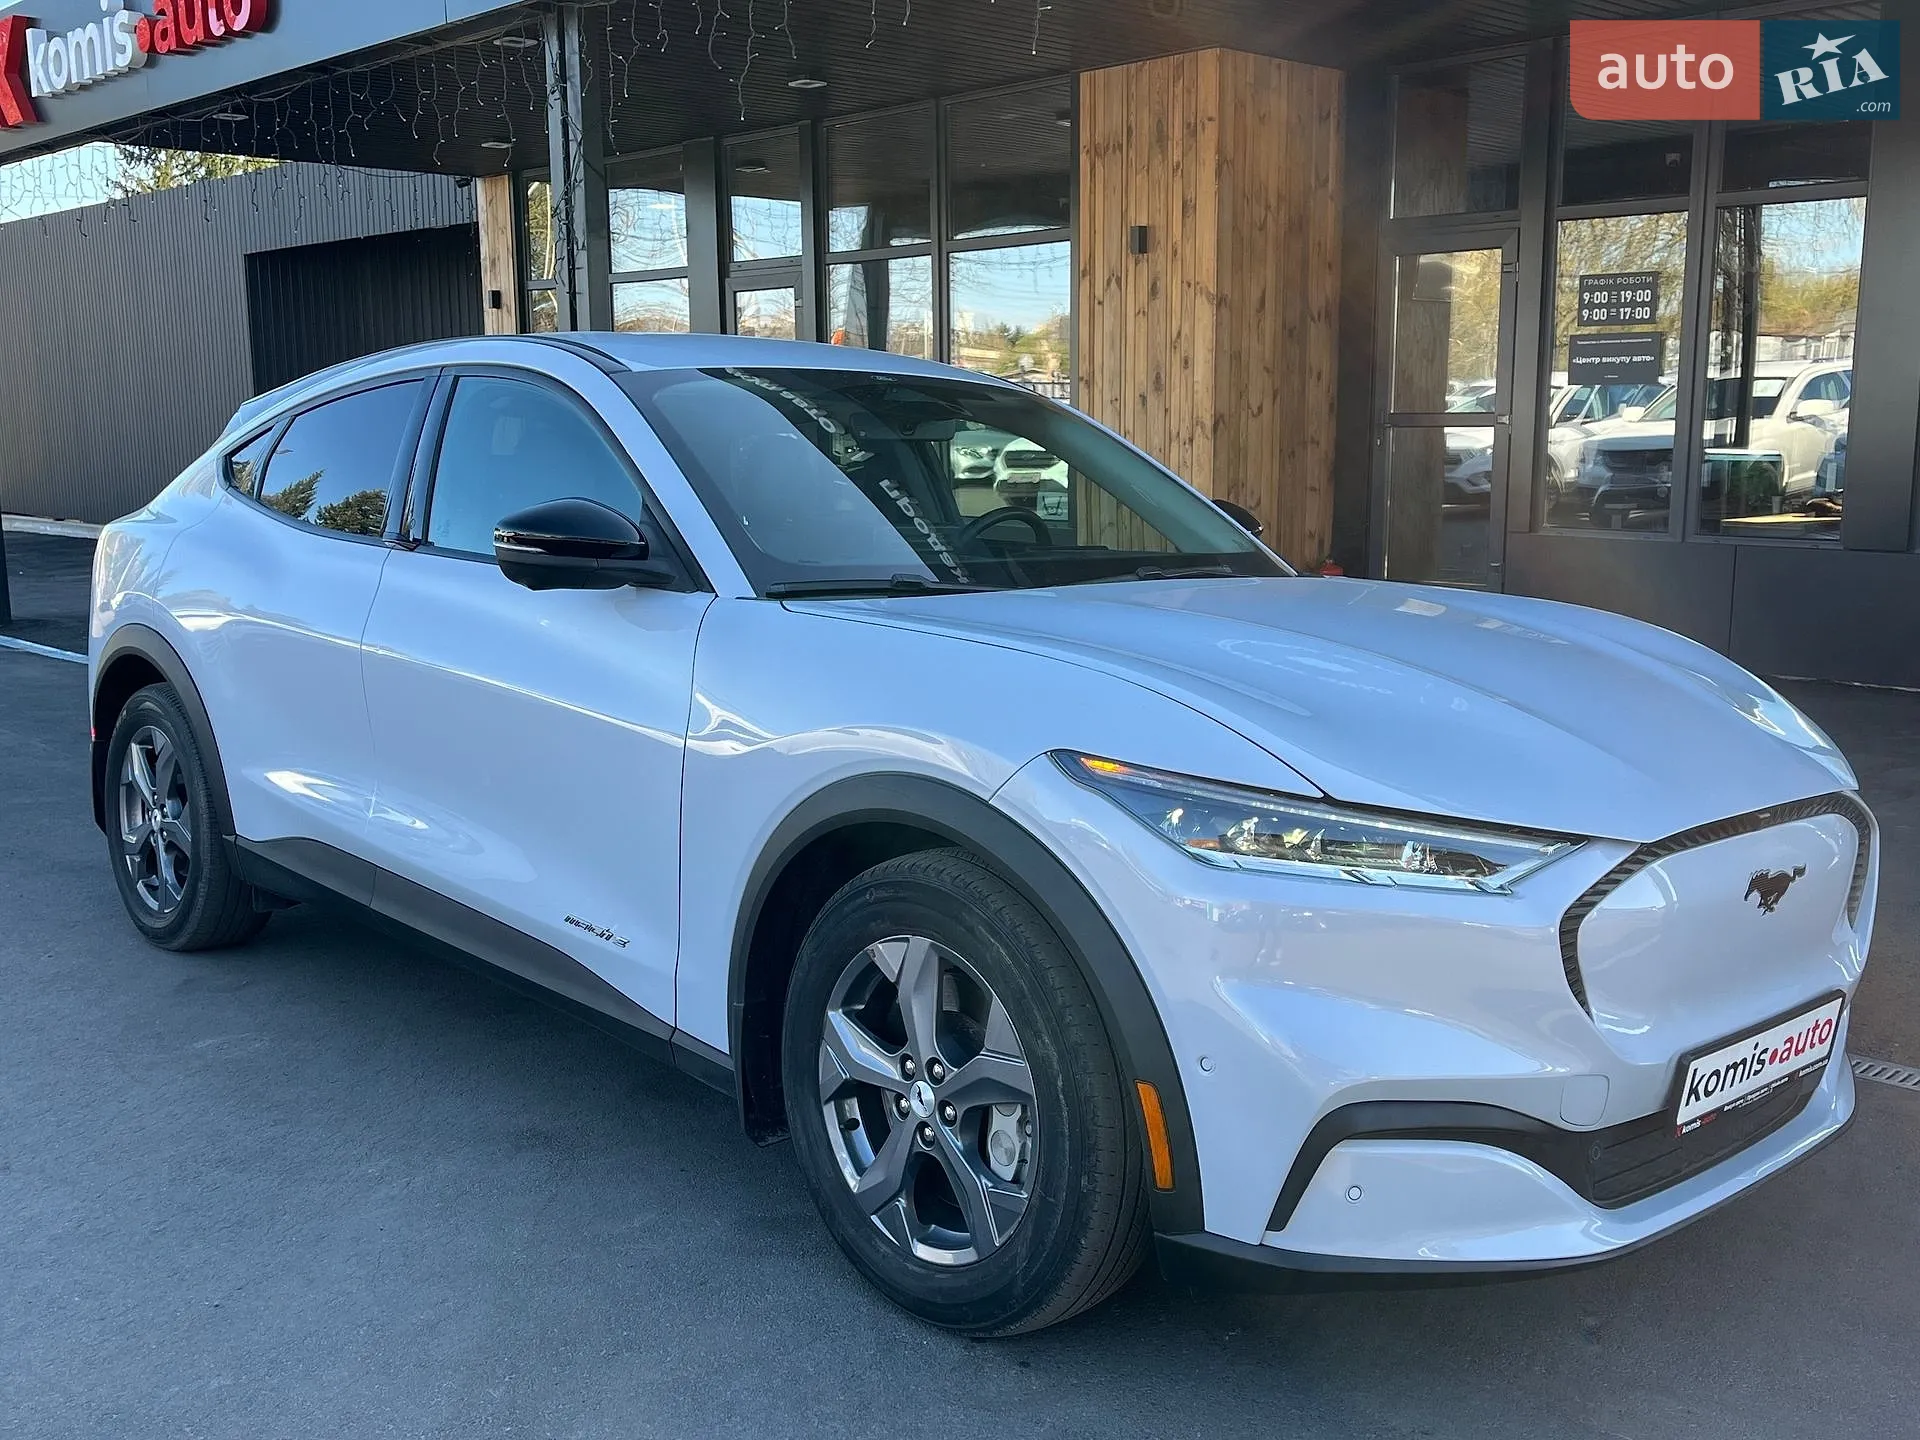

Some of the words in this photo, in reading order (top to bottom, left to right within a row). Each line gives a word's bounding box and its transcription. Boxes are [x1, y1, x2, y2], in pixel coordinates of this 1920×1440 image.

[1583, 278, 1615, 287] ГРАФІК
[1616, 275, 1653, 285] РОБОТИ
[1583, 291, 1609, 305] 9:00
[1620, 289, 1652, 303] 19:00
[1582, 308, 1608, 321] 9:00
[1619, 306, 1651, 320] 17:00
[1602, 355, 1632, 364] викупу
[1685, 1042, 1770, 1107] komis
[1778, 1018, 1834, 1065] auto
